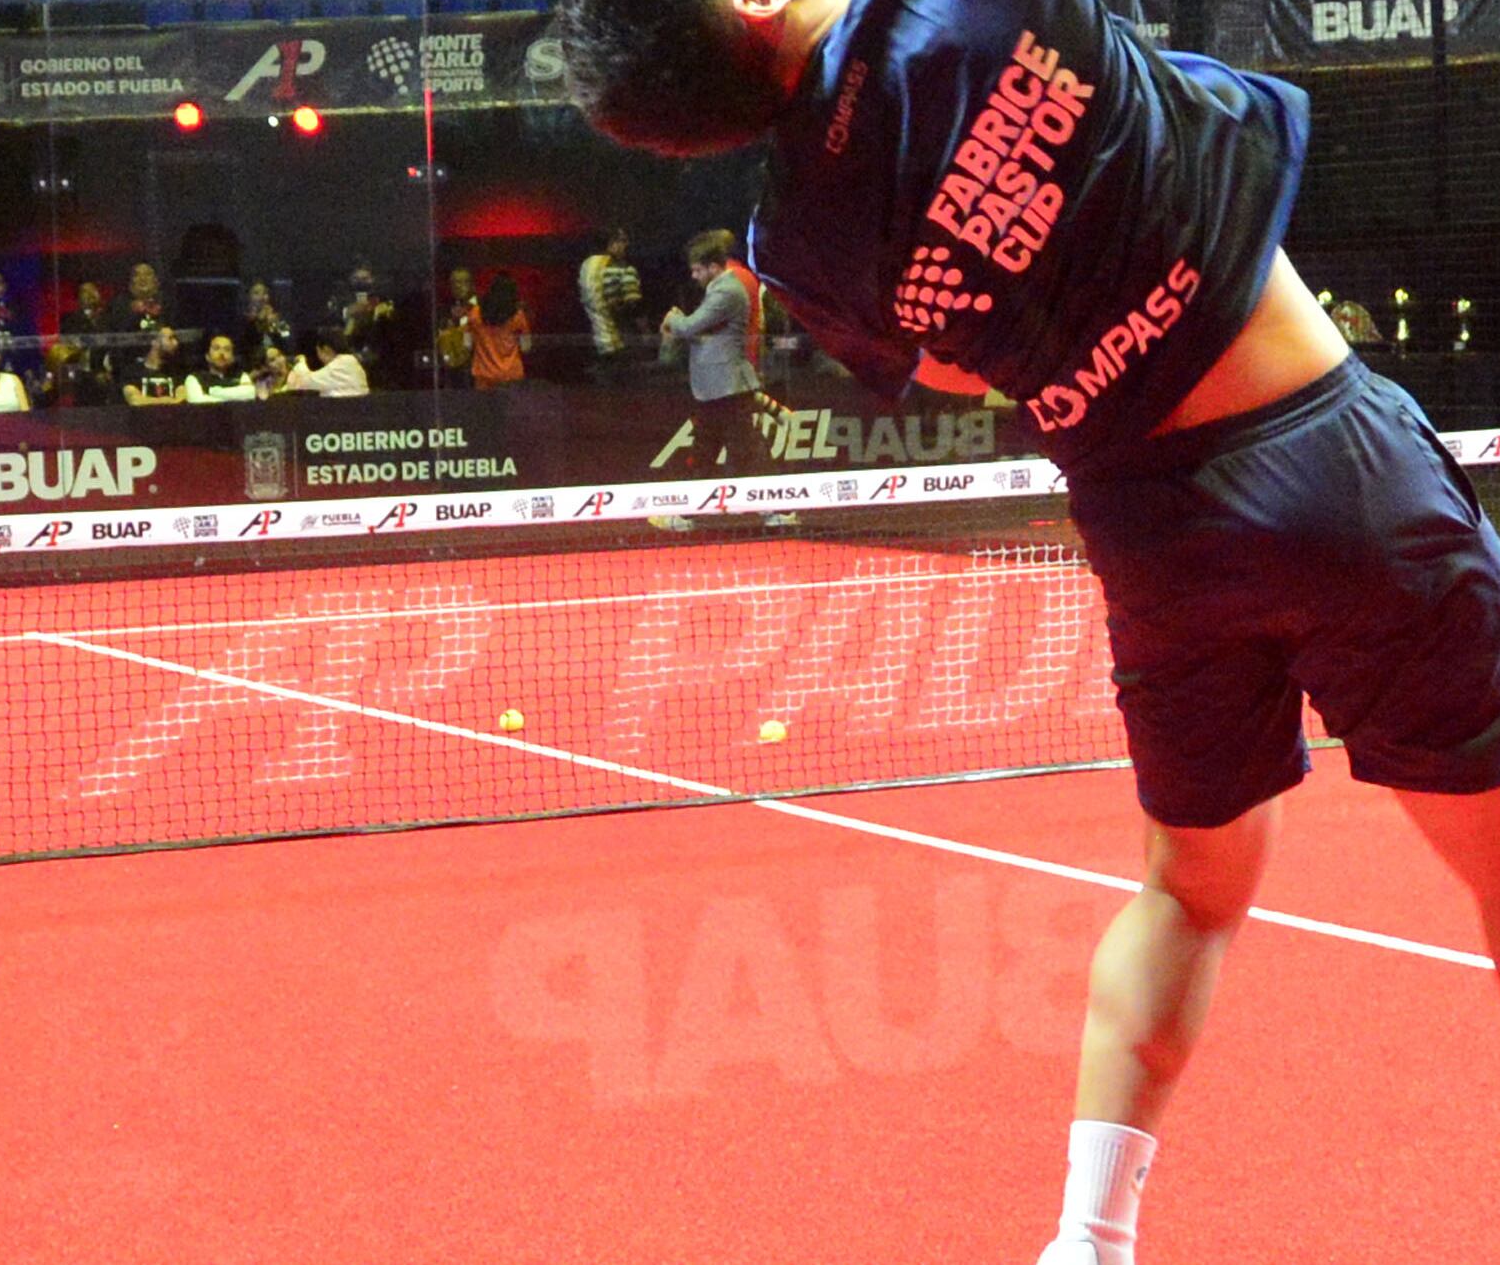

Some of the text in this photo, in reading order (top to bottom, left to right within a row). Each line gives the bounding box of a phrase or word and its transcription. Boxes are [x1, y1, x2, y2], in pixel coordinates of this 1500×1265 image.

[419, 34, 483, 52] MONTE
[20, 56, 144, 75] GOBIERNO DEL
[420, 50, 484, 68] CARLO
[21, 77, 184, 97] ESTADO DE PUEBLA
[927, 31, 1060, 236] FABRICE
[957, 67, 1095, 257] PASTOR
[992, 181, 1064, 274] CUP
[306, 428, 467, 454] GOBIERNO DEL
[307, 456, 517, 486] ESTADO DE PUEBLA
[91, 521, 152, 540] BUAP
[435, 502, 492, 521] BUAP
[747, 487, 810, 502] SIMSA
[923, 474, 975, 492] BUAP
